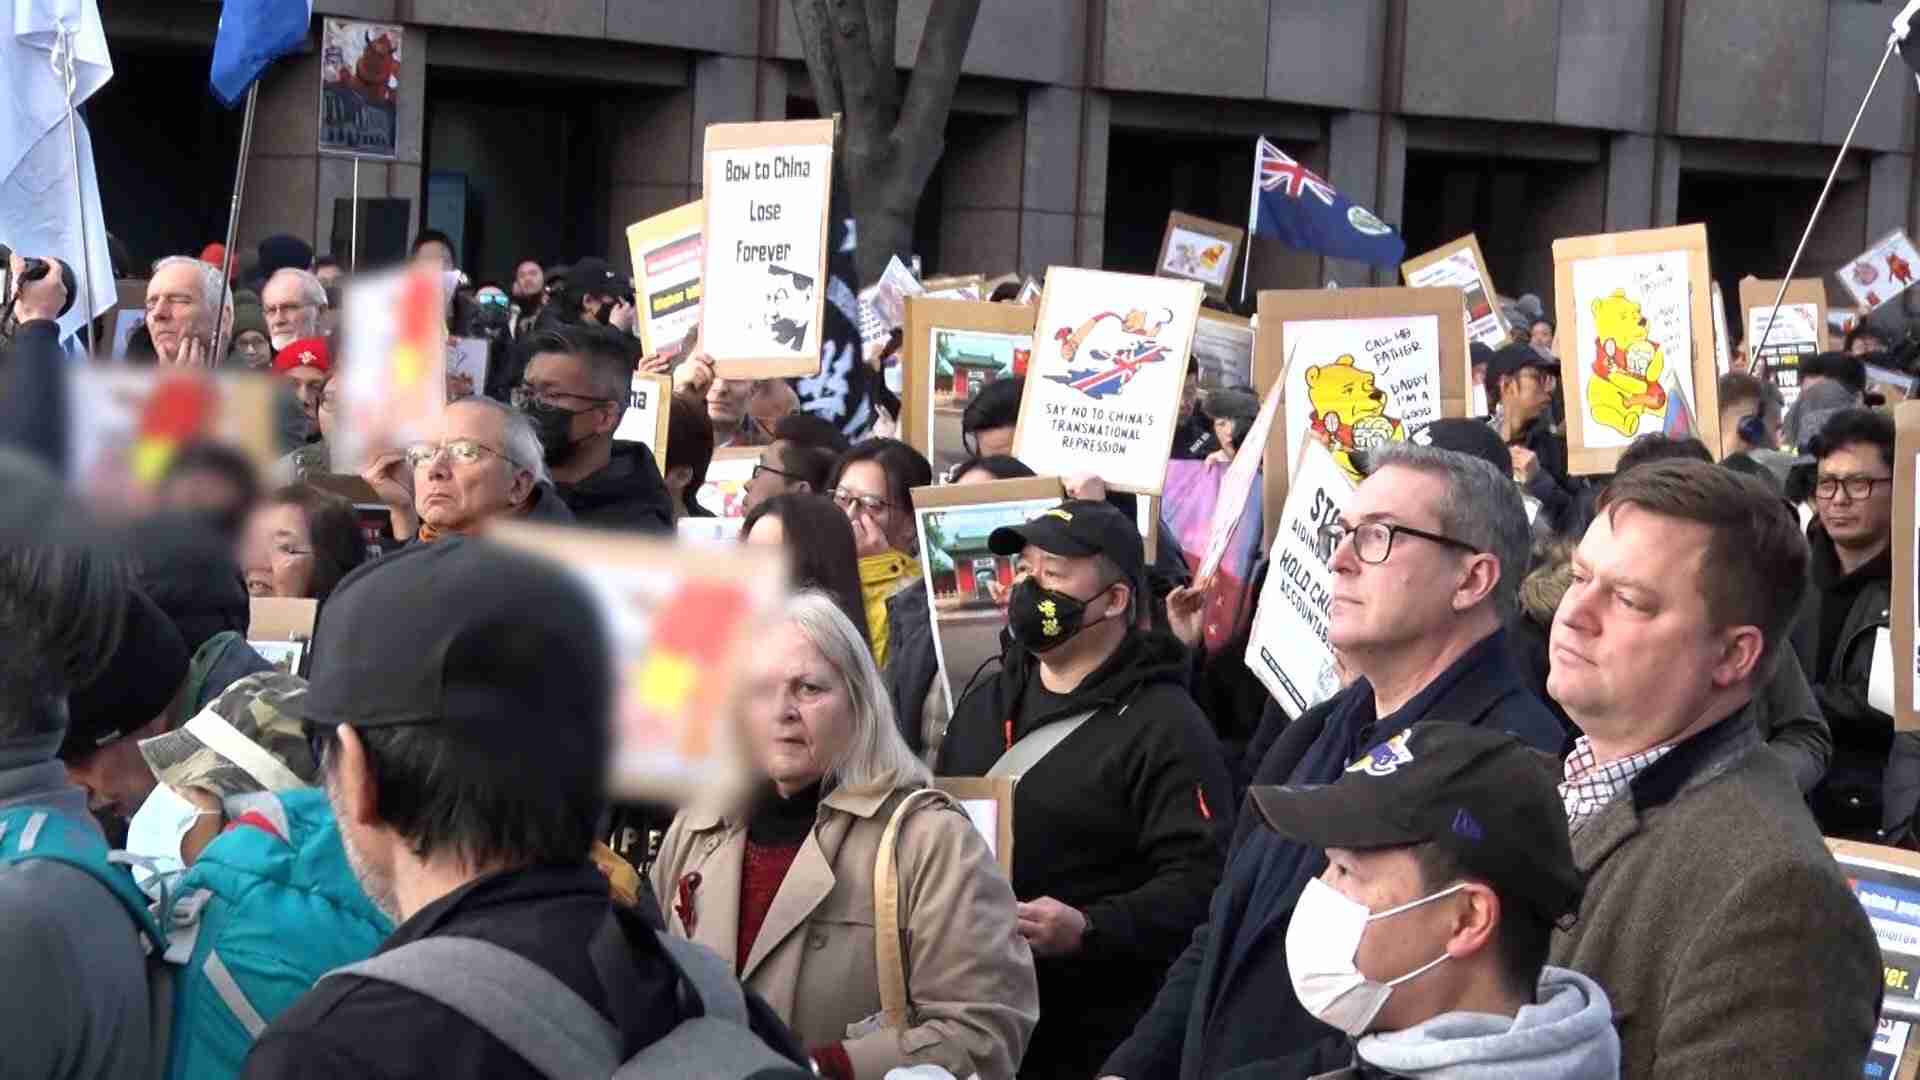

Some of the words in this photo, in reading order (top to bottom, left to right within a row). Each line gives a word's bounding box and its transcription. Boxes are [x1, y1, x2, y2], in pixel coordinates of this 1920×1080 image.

[725, 159, 751, 182] Bow
[755, 161, 770, 180] to
[774, 154, 811, 179] China
[750, 199, 782, 222] Lose
[736, 239, 792, 263] Forever
[1364, 335, 1393, 353] CALL
[1373, 340, 1422, 366] FATHER
[1390, 371, 1429, 396] DADDY
[1421, 390, 1430, 402] A
[1045, 402, 1067, 416] SAY
[1071, 406, 1088, 419] NO
[1092, 406, 1104, 420] TO
[1108, 410, 1155, 426] CHINA'S
[1051, 418, 1141, 440] TRANSNATIONAL
[1061, 434, 1127, 454] REPRESSION
[1279, 547, 1311, 592] HOLD
[1309, 580, 1334, 618] CHI
